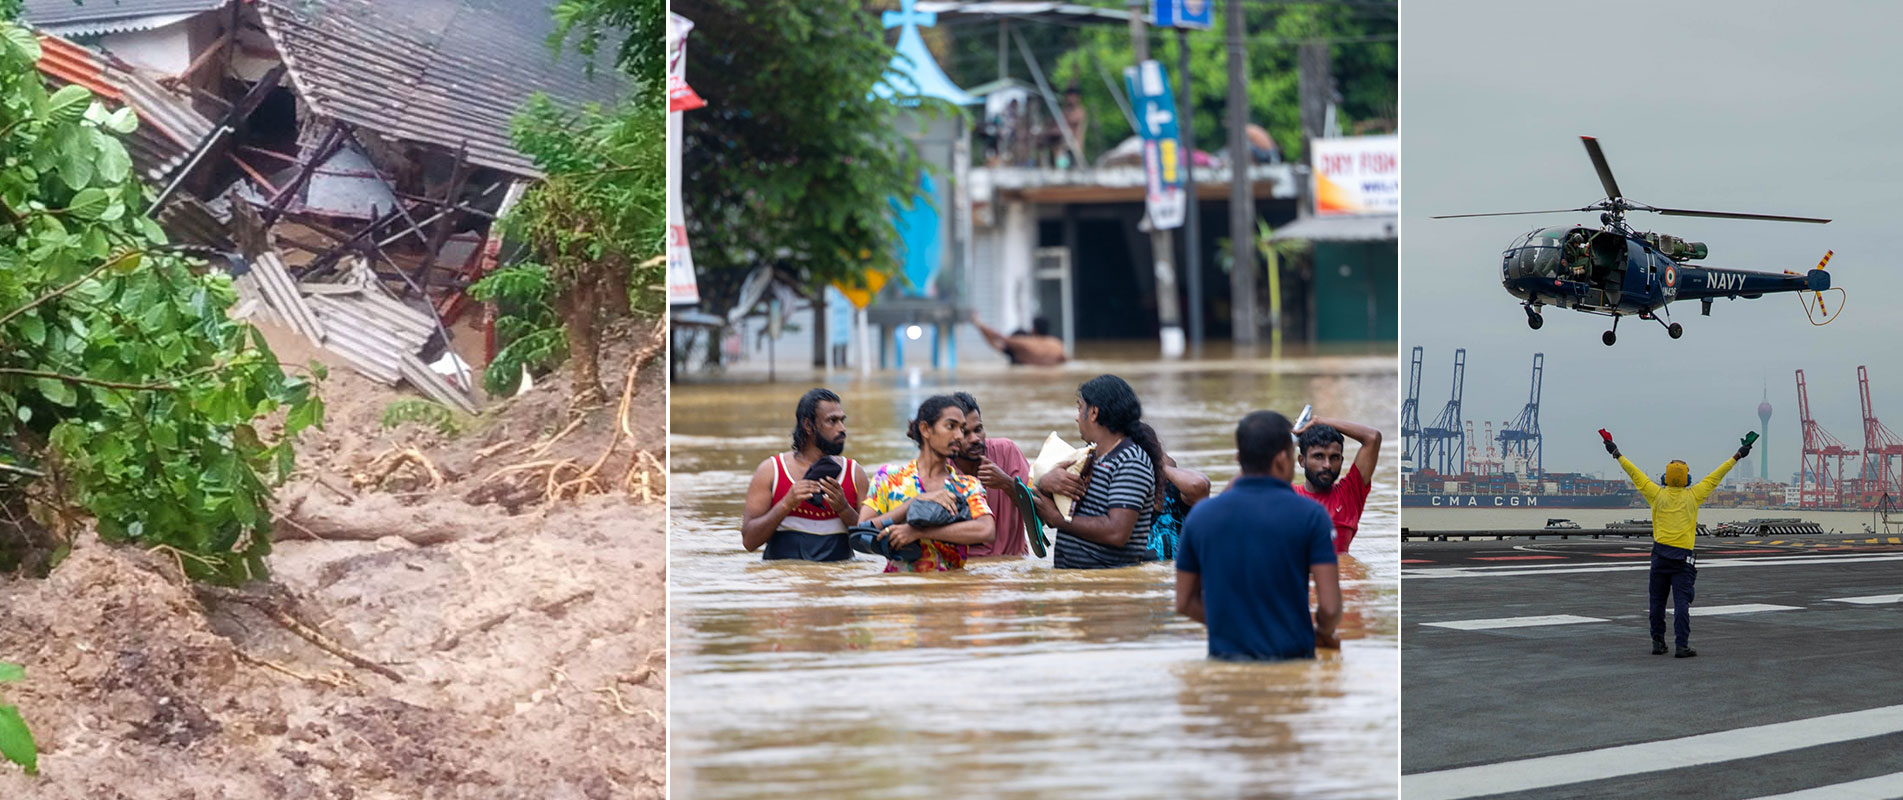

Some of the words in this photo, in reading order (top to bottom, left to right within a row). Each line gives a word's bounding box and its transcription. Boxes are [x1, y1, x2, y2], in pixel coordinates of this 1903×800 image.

[1706, 271, 1747, 290] NAVY
[1432, 496, 1477, 506] CMA
[1494, 496, 1537, 506] CGM
